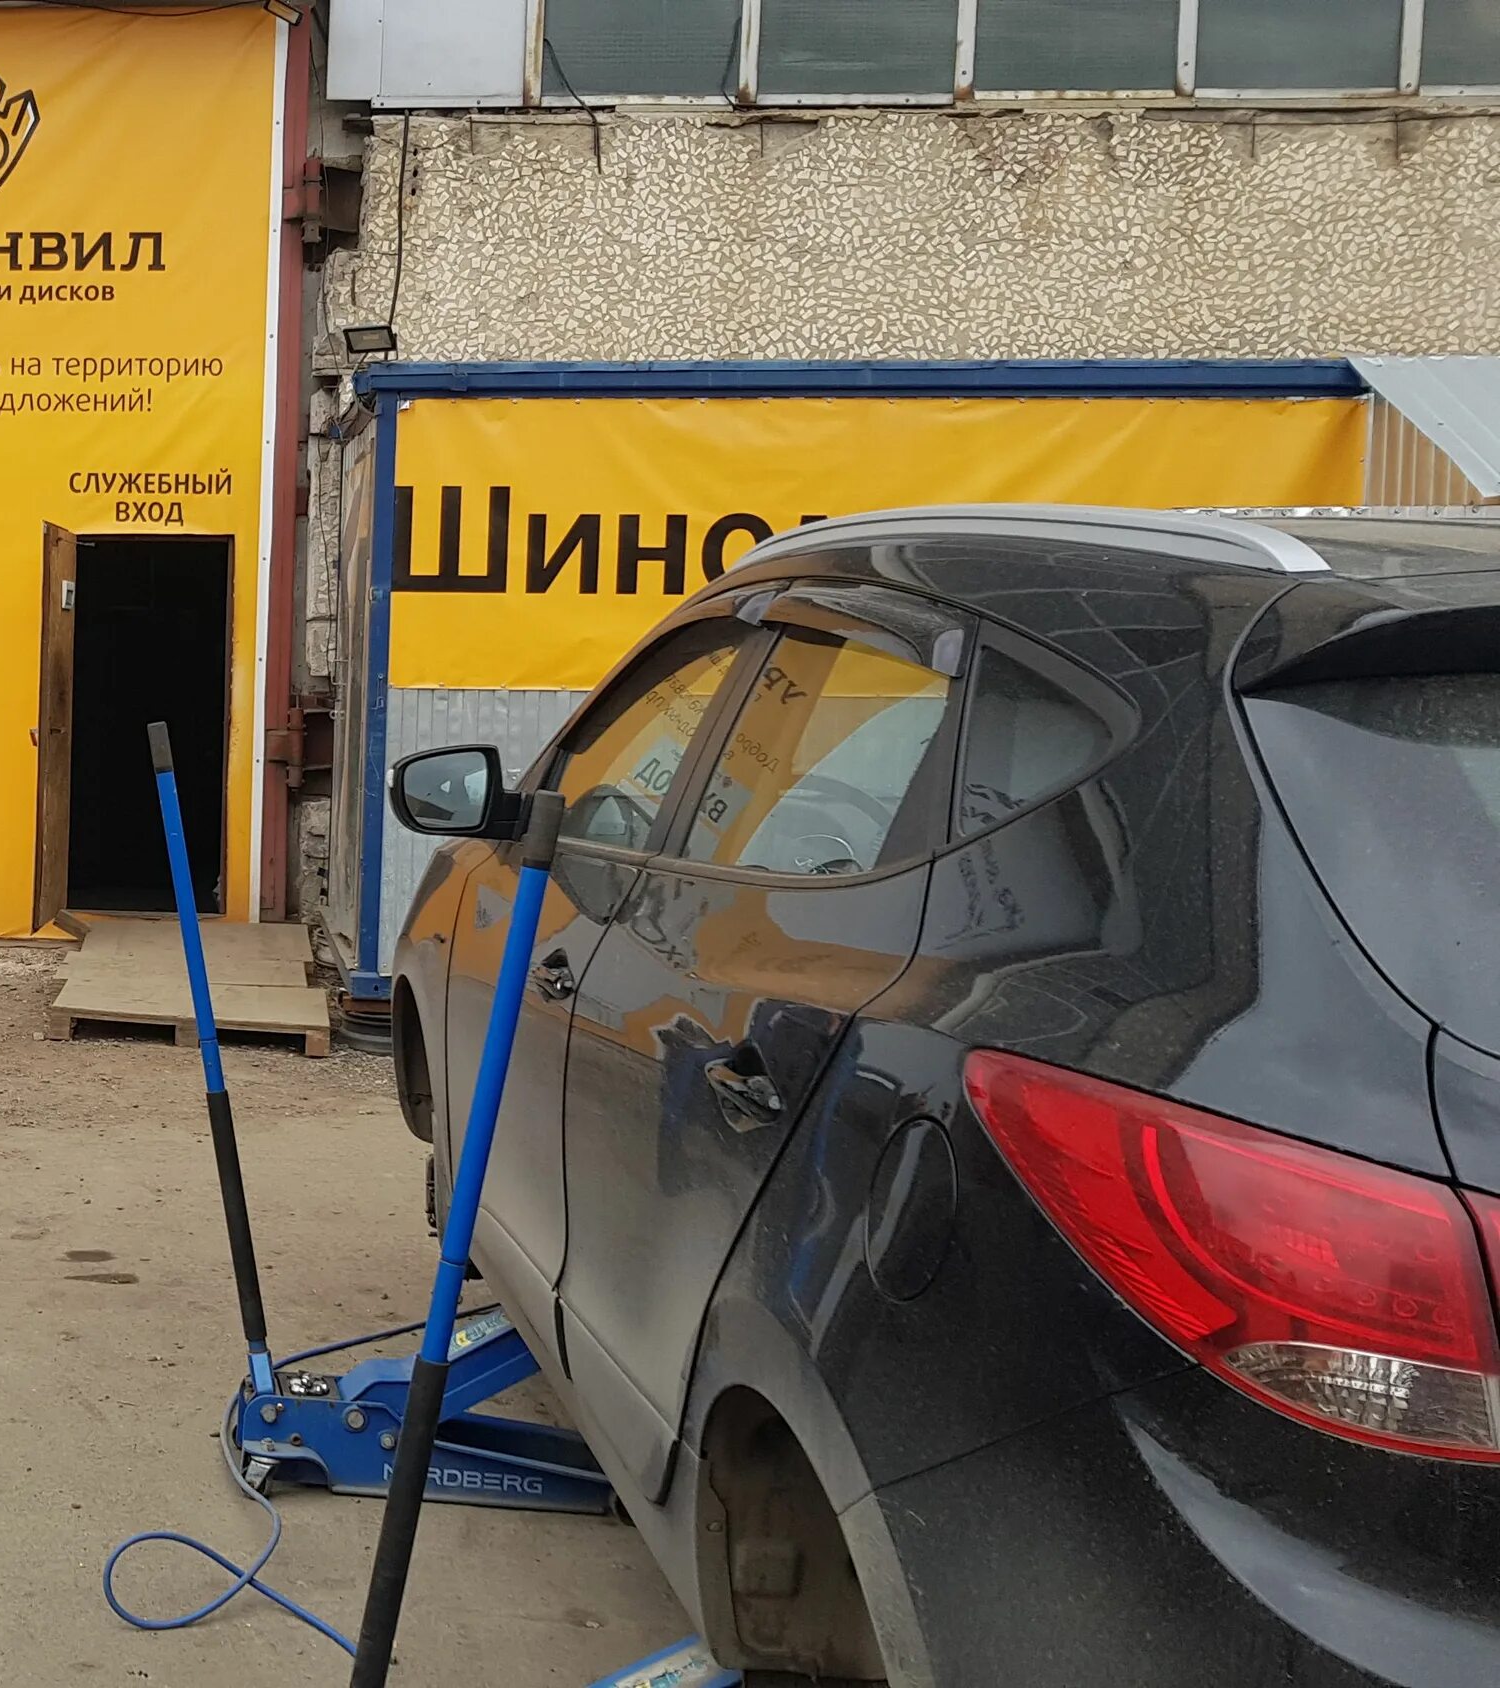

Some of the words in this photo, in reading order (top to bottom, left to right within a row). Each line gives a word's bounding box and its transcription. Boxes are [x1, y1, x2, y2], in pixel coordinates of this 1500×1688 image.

[18, 284, 115, 305] дисков
[11, 357, 41, 377] на
[51, 357, 223, 385] территорию
[69, 467, 232, 496] СЛУЖЕБНЫЙ
[115, 500, 184, 527] ВХОД
[392, 486, 828, 595] Шино
[383, 1463, 543, 1495] NRDBERG
